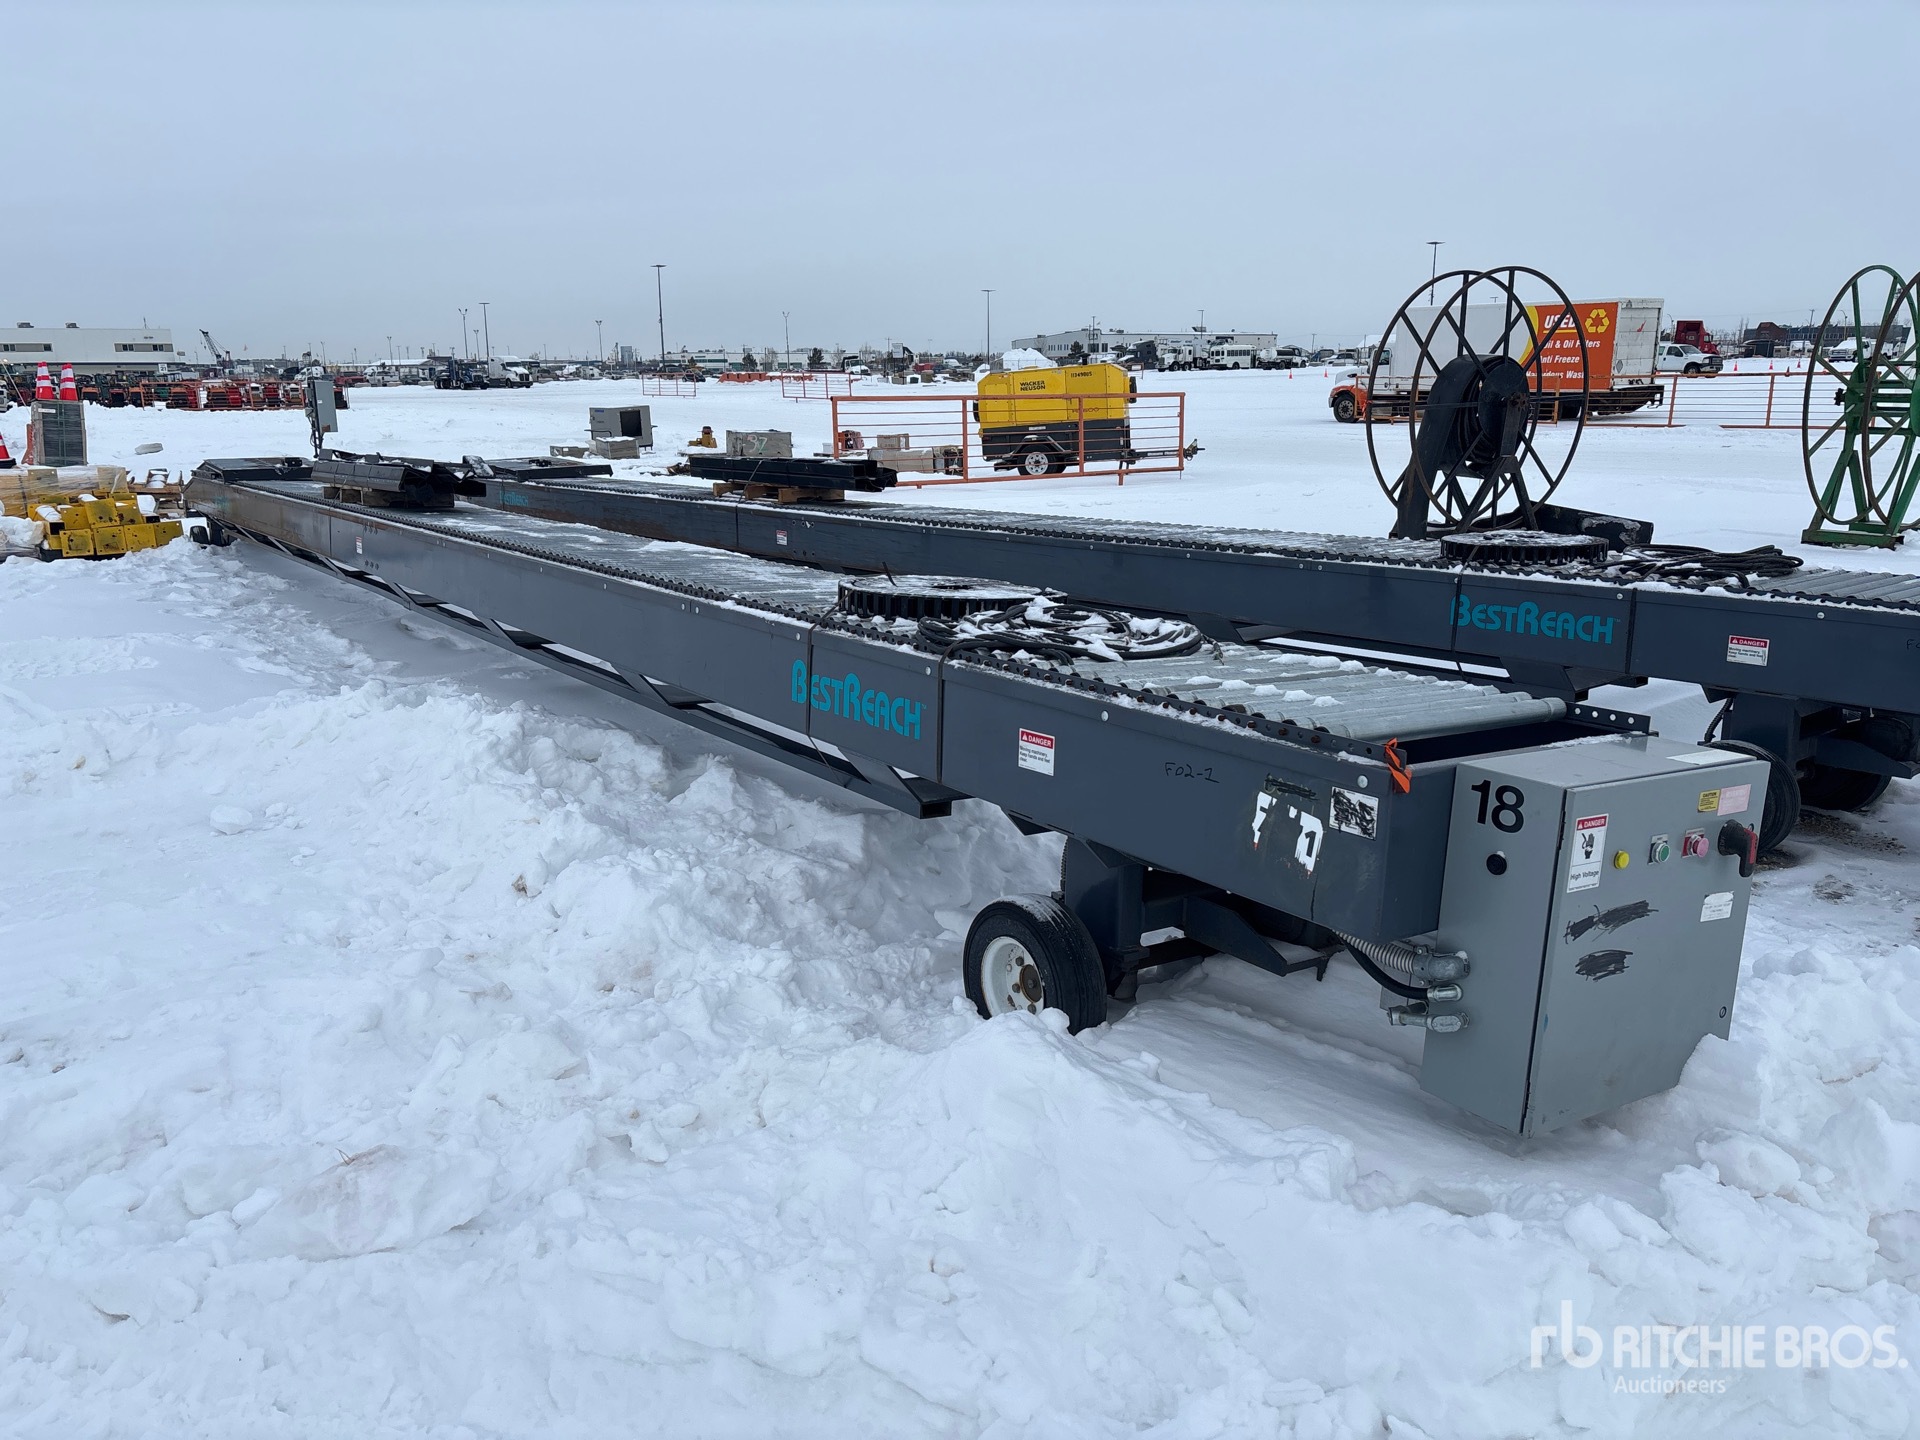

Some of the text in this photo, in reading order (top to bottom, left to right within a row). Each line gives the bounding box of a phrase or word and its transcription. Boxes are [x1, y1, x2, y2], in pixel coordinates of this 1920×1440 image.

[1555, 340, 1562, 349] &
[1563, 340, 1574, 349] Oil
[1575, 340, 1601, 348] Fters
[1554, 355, 1580, 364] Freeze
[1566, 370, 1585, 379] Wast
[1028, 735, 1052, 747] DANGER
[1471, 779, 1525, 833] 18
[1584, 819, 1605, 828] DANGER
[1570, 870, 1599, 881] High Voltage
